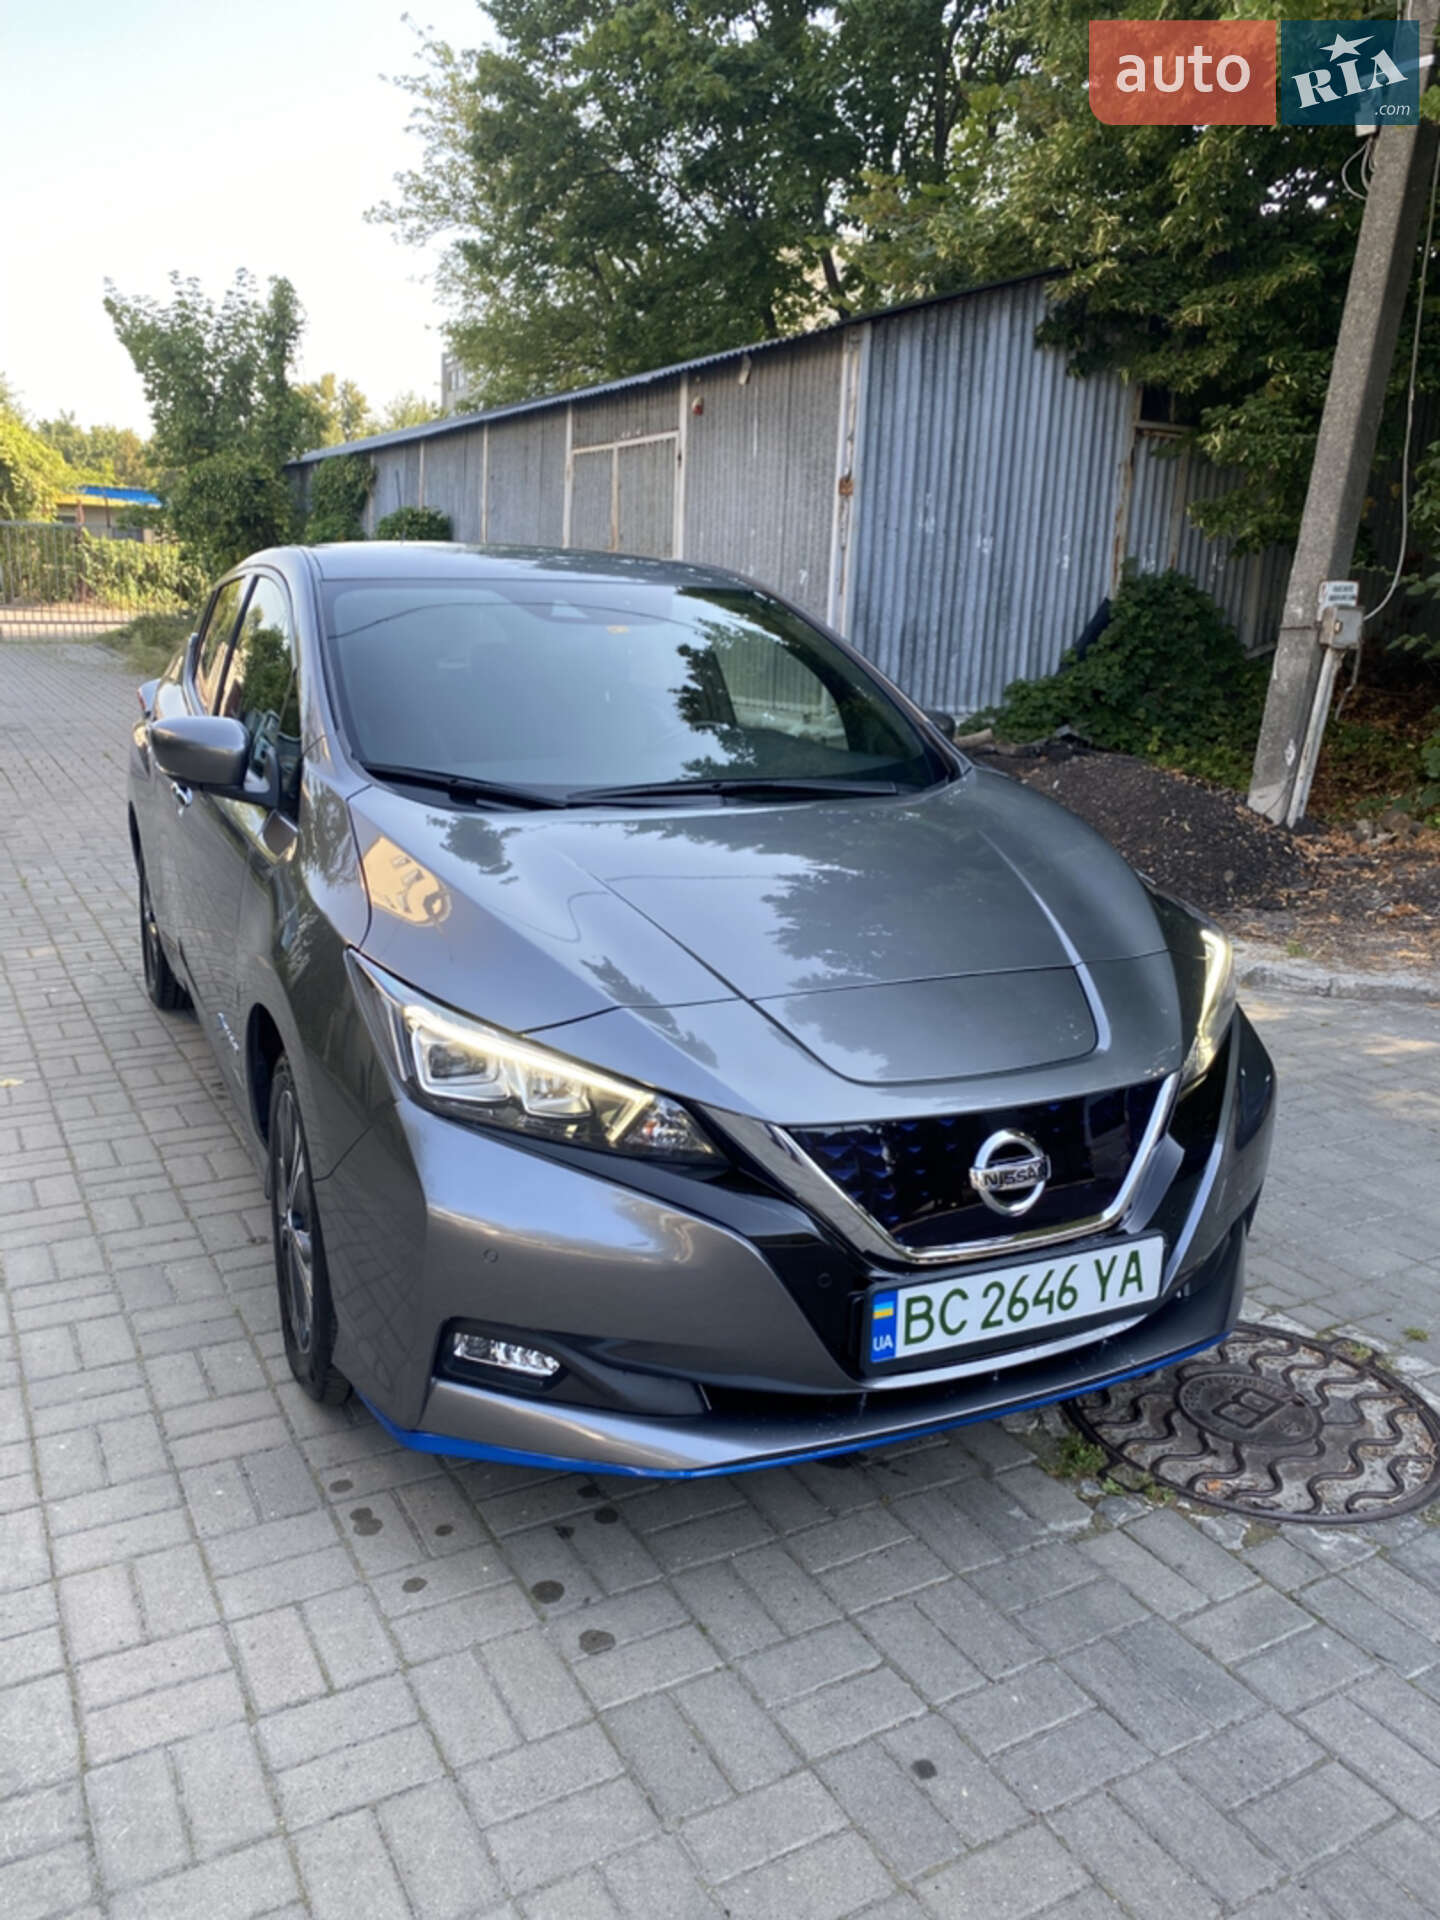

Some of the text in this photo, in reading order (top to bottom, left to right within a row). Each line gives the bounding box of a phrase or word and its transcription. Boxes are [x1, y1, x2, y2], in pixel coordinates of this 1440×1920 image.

[904, 1250, 1144, 1346] BC 2646 YA
[873, 1334, 893, 1351] UA
